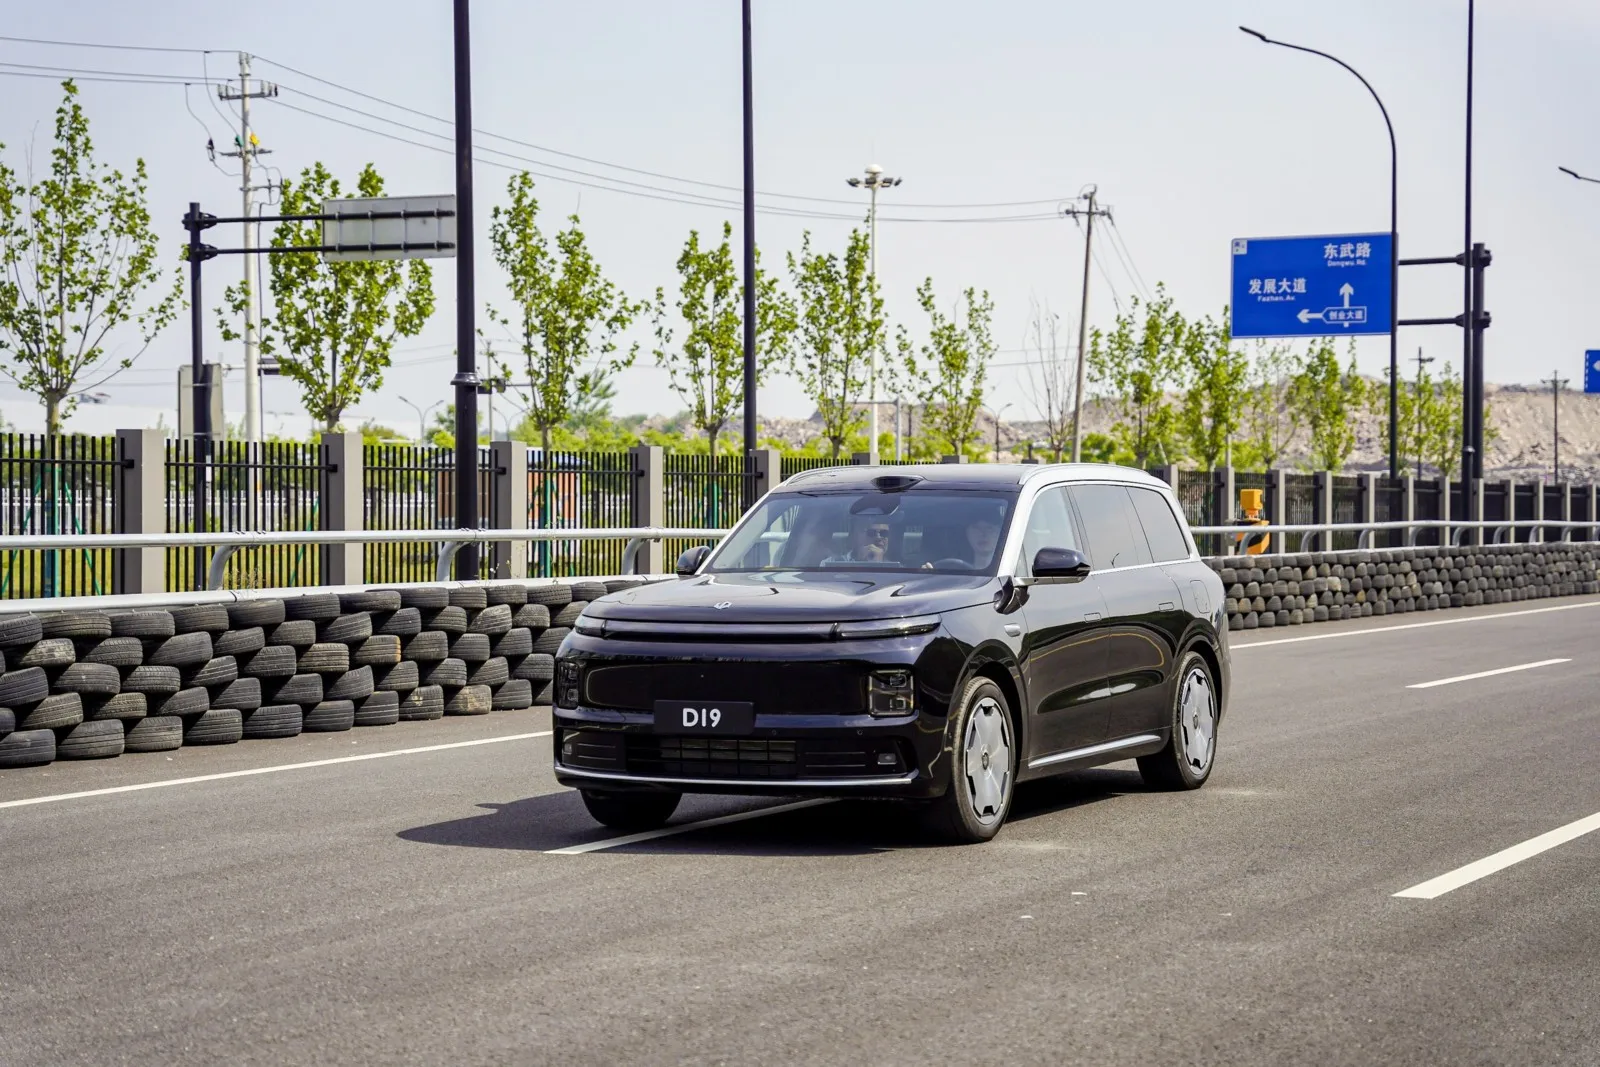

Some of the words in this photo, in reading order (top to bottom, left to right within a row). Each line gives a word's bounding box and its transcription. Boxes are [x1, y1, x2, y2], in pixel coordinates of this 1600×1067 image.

[1324, 242, 1371, 259] 东武路
[1248, 277, 1307, 295] 发展大道
[682, 707, 721, 728] D19
